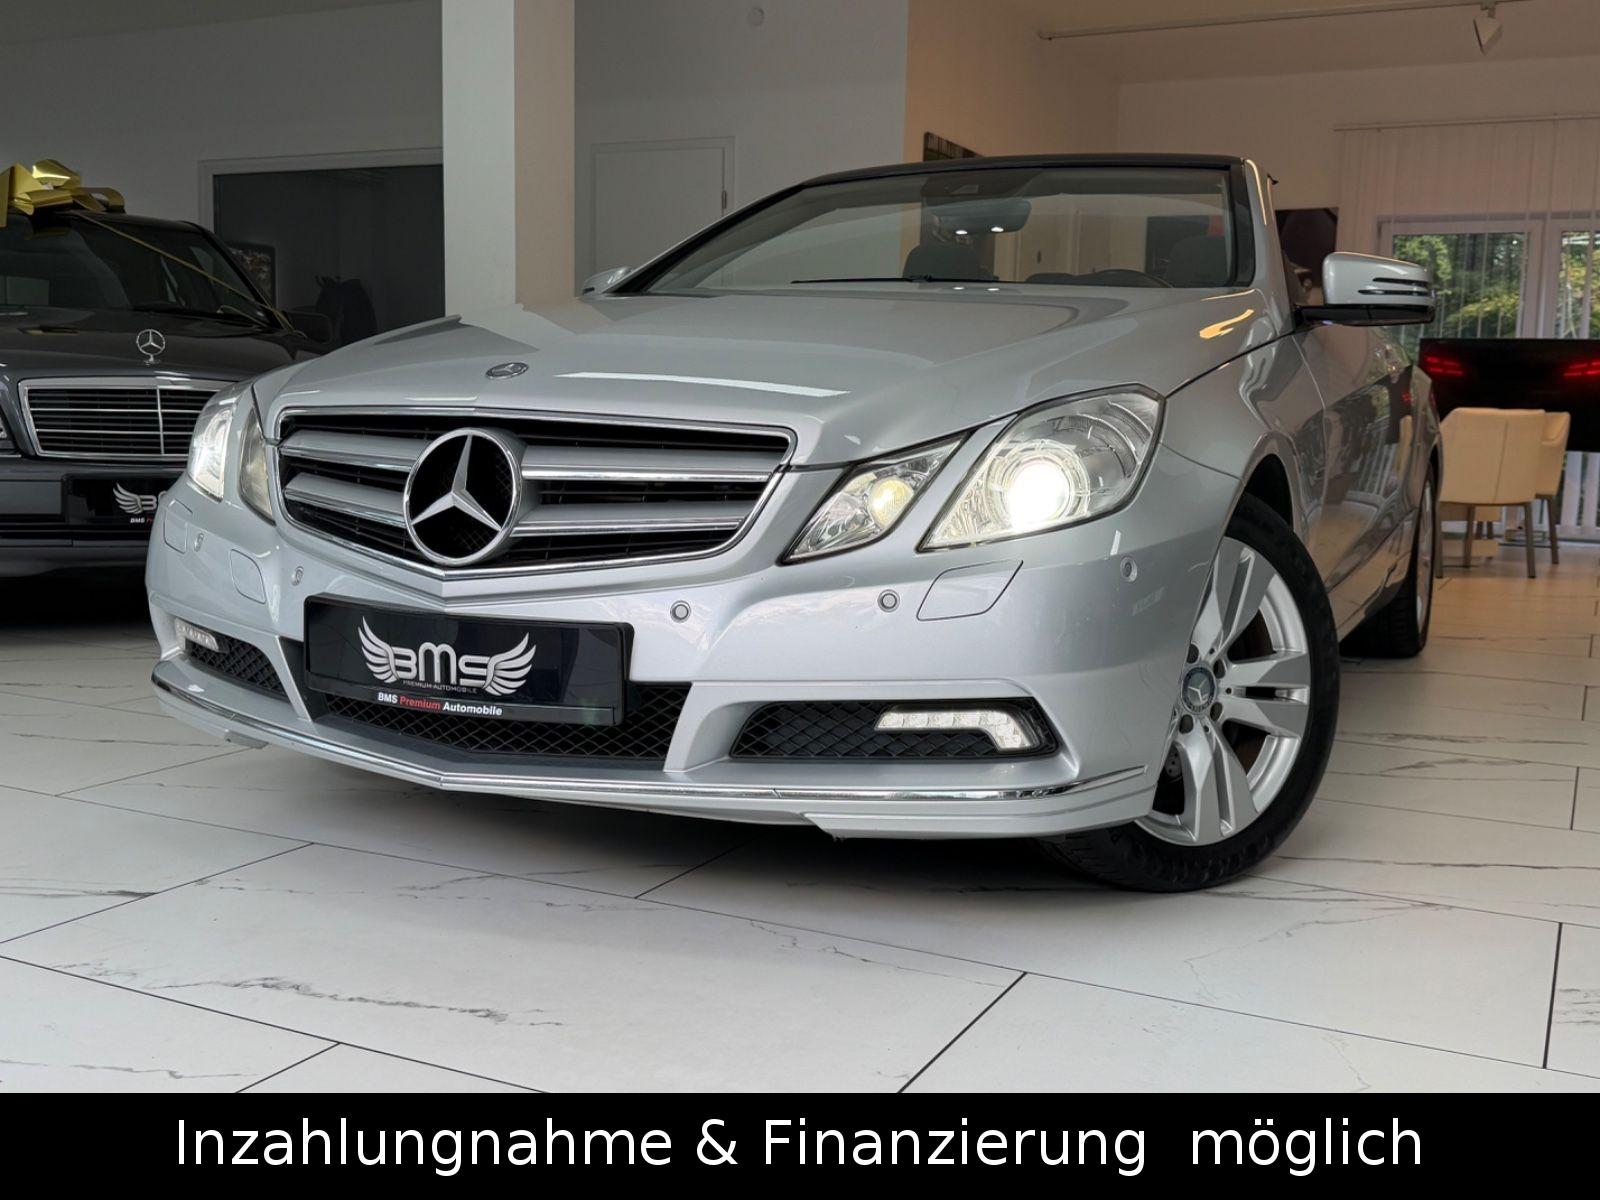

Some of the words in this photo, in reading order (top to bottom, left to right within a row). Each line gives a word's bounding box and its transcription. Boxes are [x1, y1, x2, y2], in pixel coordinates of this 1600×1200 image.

[392, 642, 491, 688] BMS
[377, 692, 398, 704] BMS
[399, 696, 441, 710] Premium
[442, 701, 503, 716] Automobile
